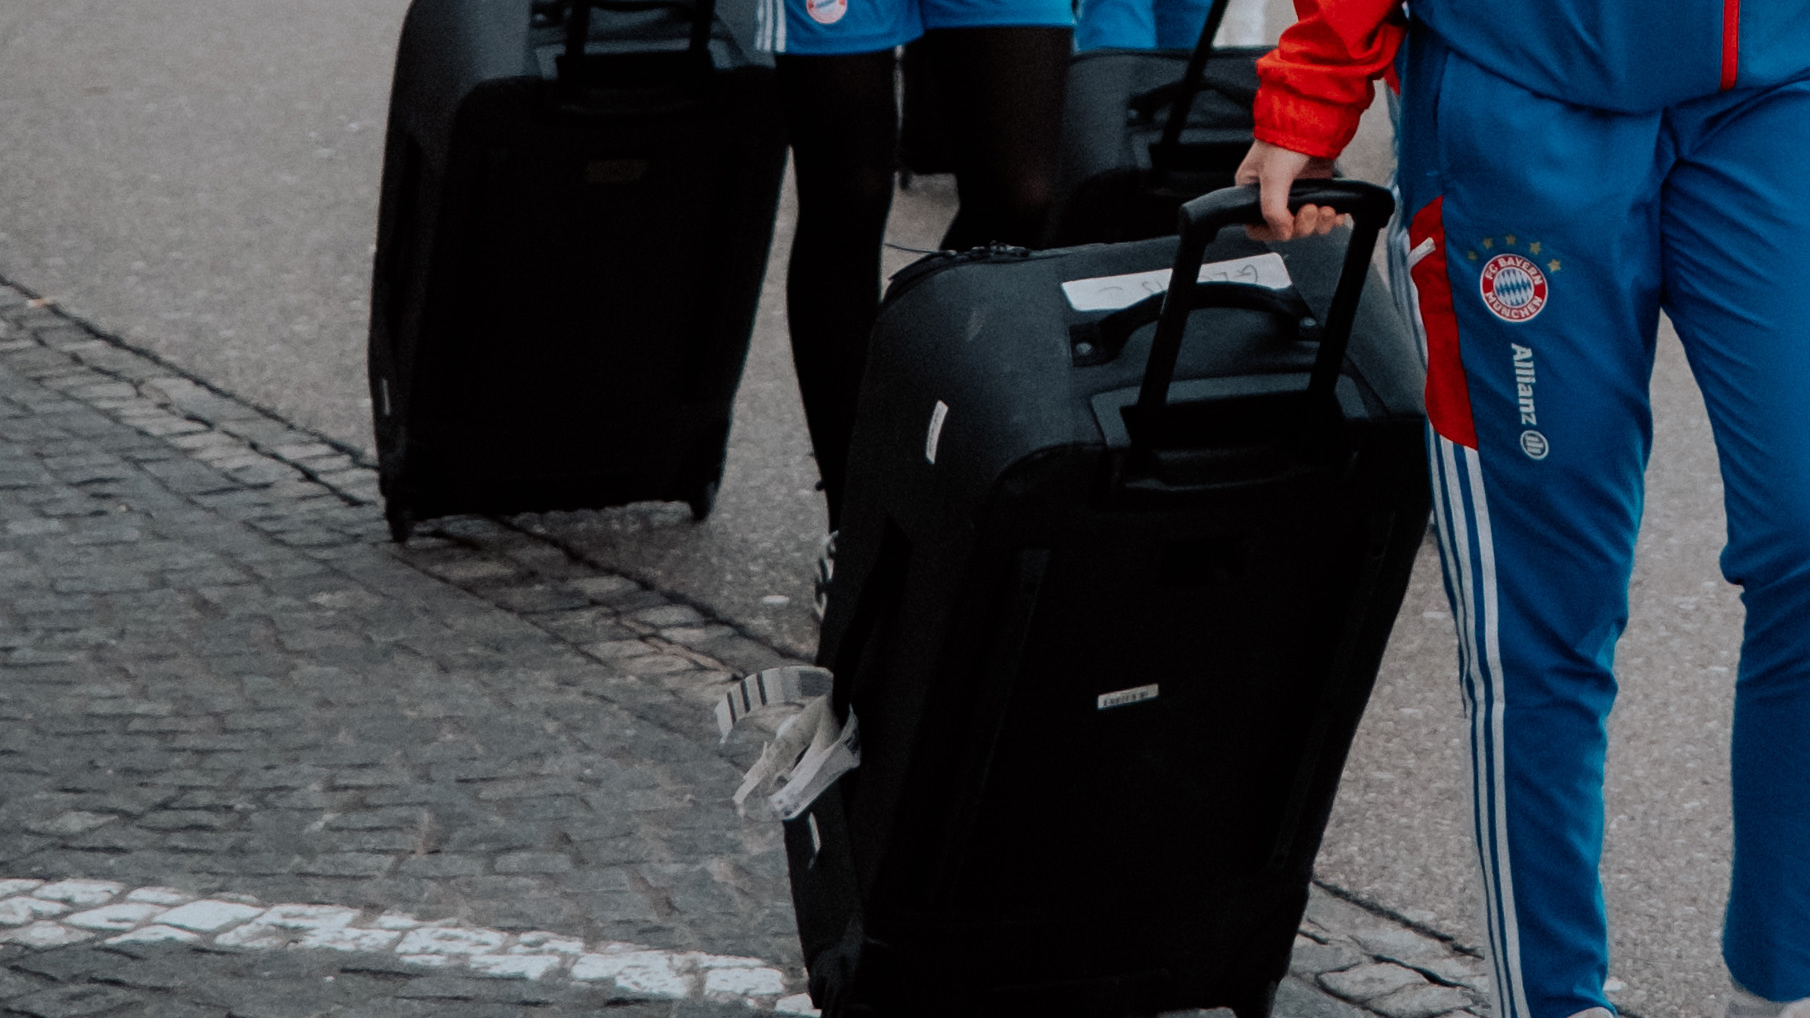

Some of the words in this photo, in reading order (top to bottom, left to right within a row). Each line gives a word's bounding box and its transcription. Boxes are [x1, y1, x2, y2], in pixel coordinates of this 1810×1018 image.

[1484, 262, 1499, 280] FC
[1498, 256, 1544, 286] BAYERN
[1511, 343, 1538, 426] Allianz
